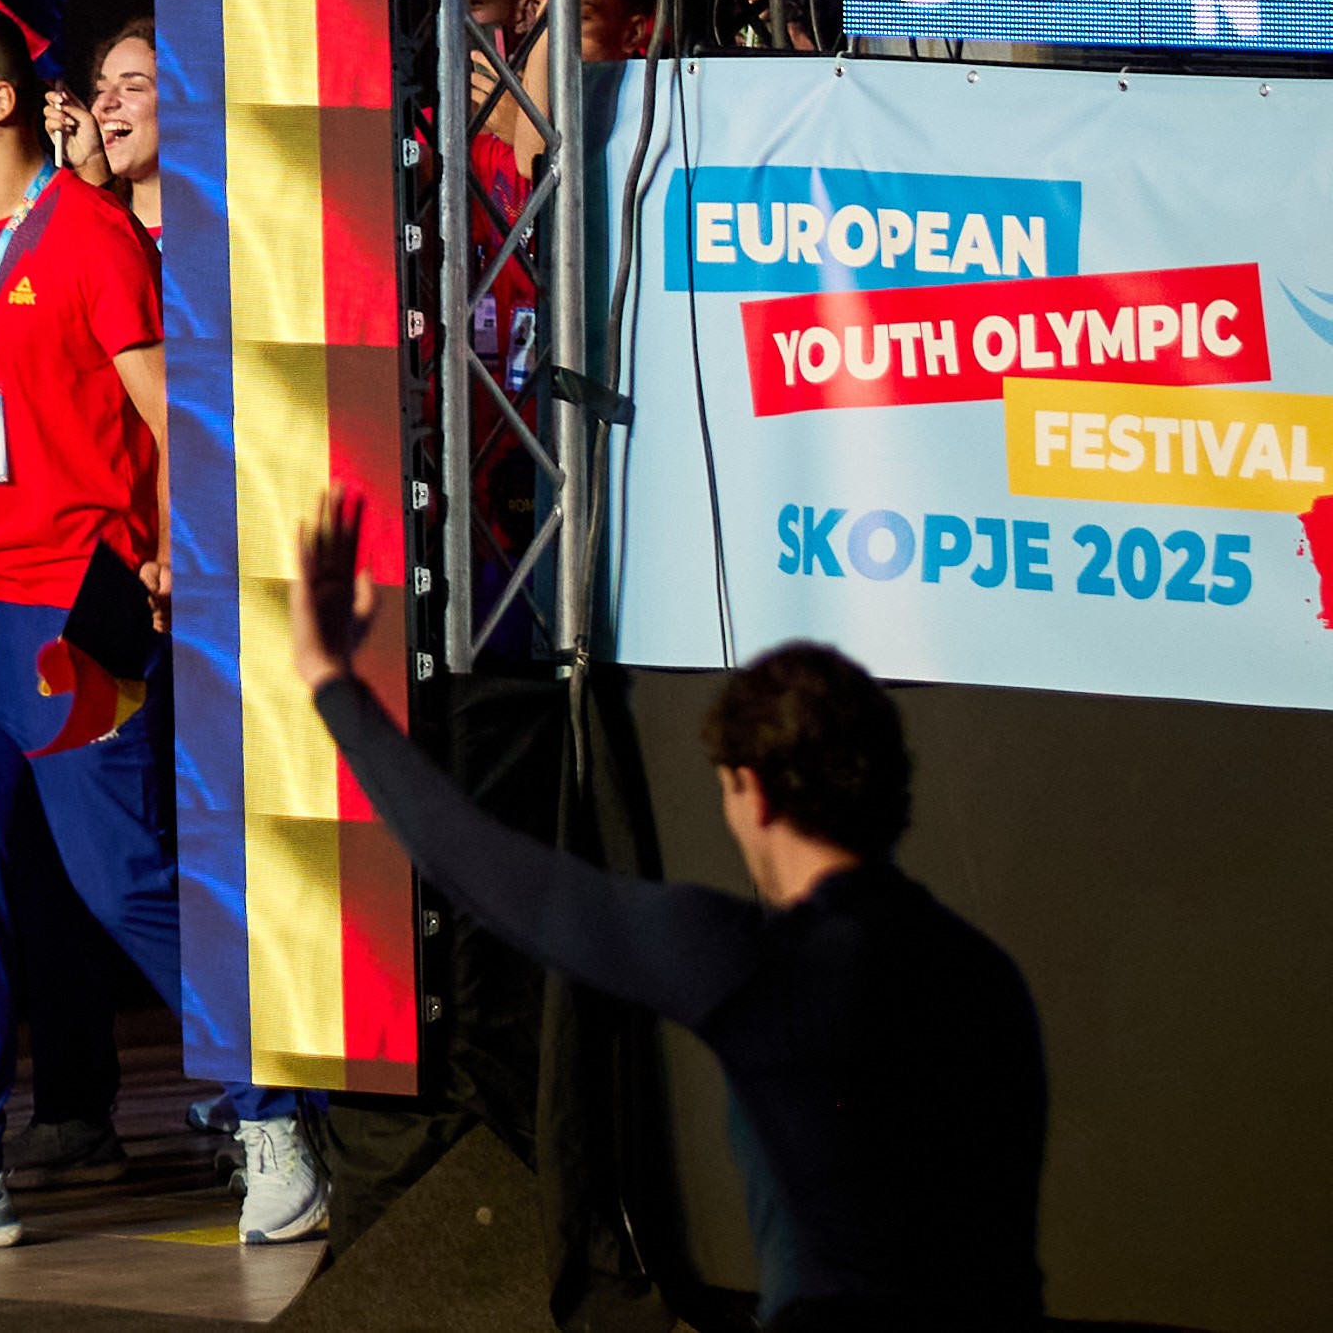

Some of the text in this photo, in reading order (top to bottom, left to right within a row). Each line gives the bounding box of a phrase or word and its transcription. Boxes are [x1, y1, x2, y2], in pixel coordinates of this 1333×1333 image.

[695, 201, 1047, 278] EUROPEAN
[773, 298, 1243, 387] YOUTH OLYMPIC
[1034, 410, 1325, 483] FESTIVAL
[777, 502, 1254, 606] SKOPJE 2025
